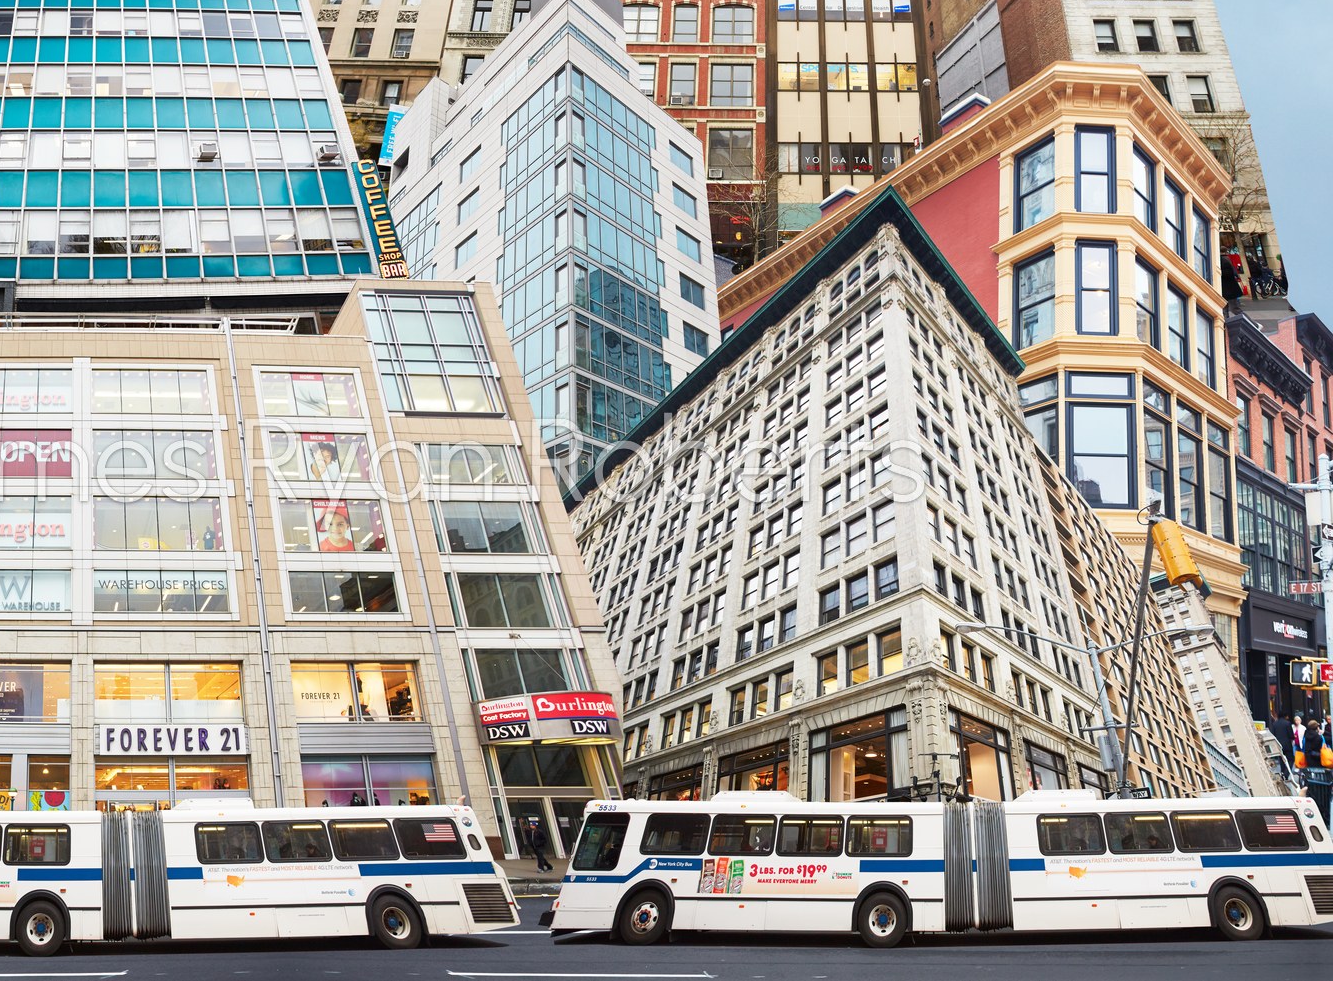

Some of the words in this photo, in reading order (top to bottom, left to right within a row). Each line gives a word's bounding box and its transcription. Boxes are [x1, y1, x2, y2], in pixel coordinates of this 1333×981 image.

[358, 159, 399, 253] COFFEE
[379, 252, 402, 261] SHOP
[383, 264, 407, 278] BAR
[0, 441, 70, 462] OPEN
[99, 579, 180, 590] WAREHOUSE
[182, 579, 227, 590] PRICES.
[1291, 584, 1297, 593] E
[1300, 583, 1308, 593] 17
[1311, 582, 1321, 592] ST
[2, 601, 61, 610] WAREHOUSE
[481, 700, 524, 712] Burlington
[536, 697, 614, 715] Burlington
[483, 714, 499, 722] Coat
[499, 711, 527, 720] Factory
[488, 724, 526, 739] DSW
[572, 720, 608, 734] DSW
[106, 728, 210, 752] FOREVER
[220, 728, 241, 752] 21
[750, 864, 758, 877] 3
